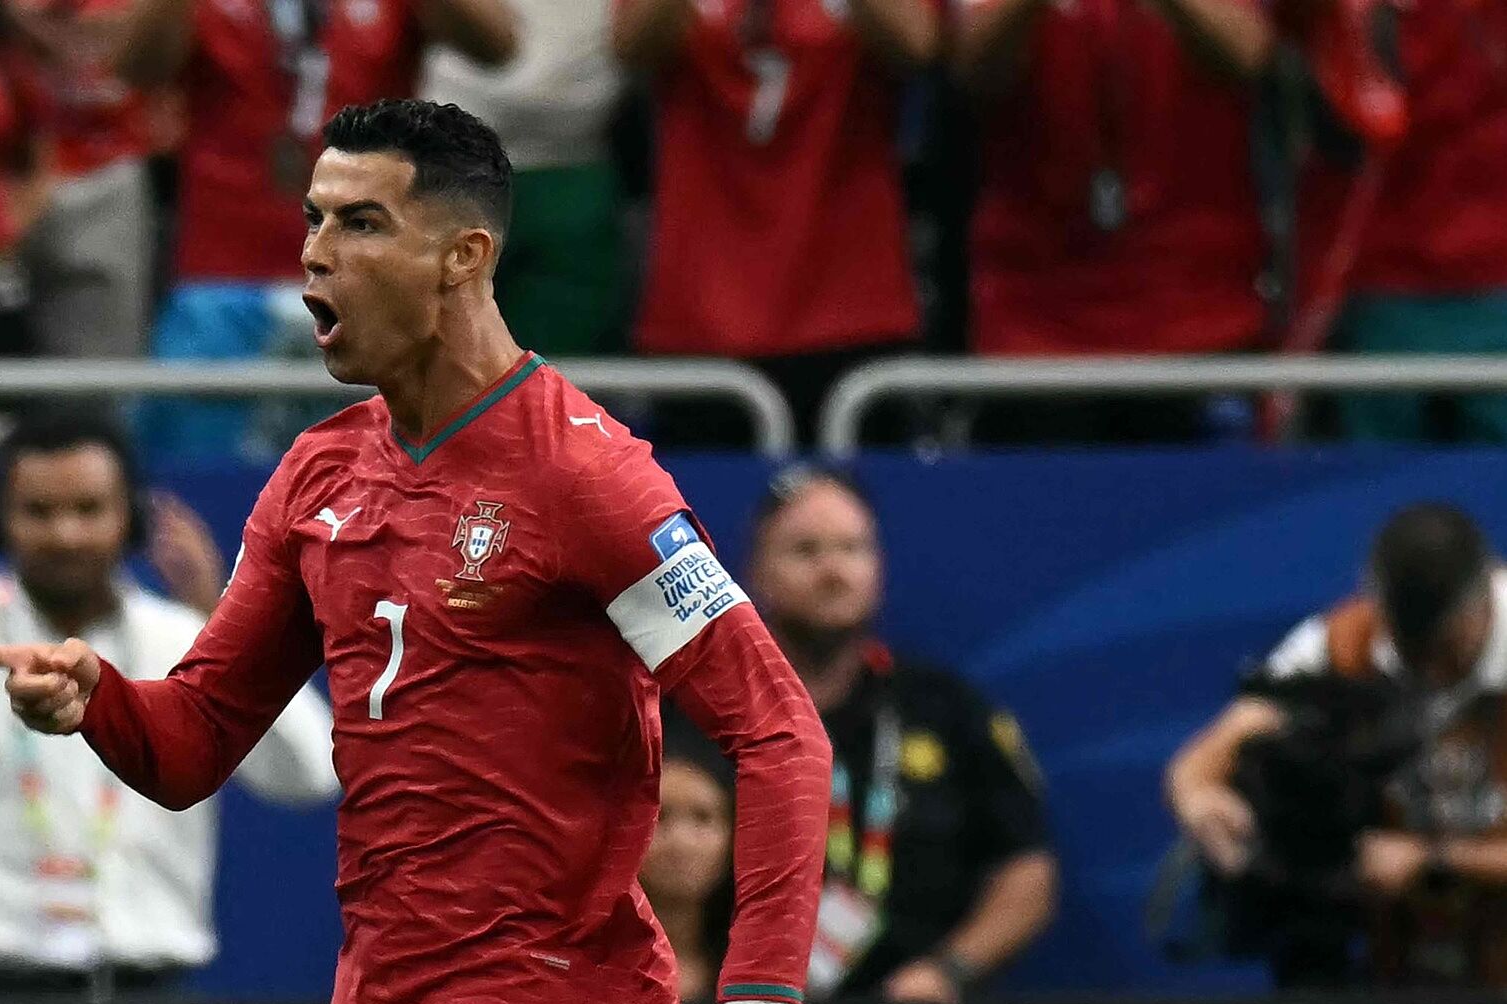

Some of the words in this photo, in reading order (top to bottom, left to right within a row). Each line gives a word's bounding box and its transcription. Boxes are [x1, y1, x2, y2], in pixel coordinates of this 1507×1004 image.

[664, 560, 722, 607] UNITES
[673, 599, 701, 622] the
[370, 600, 408, 720] 7
